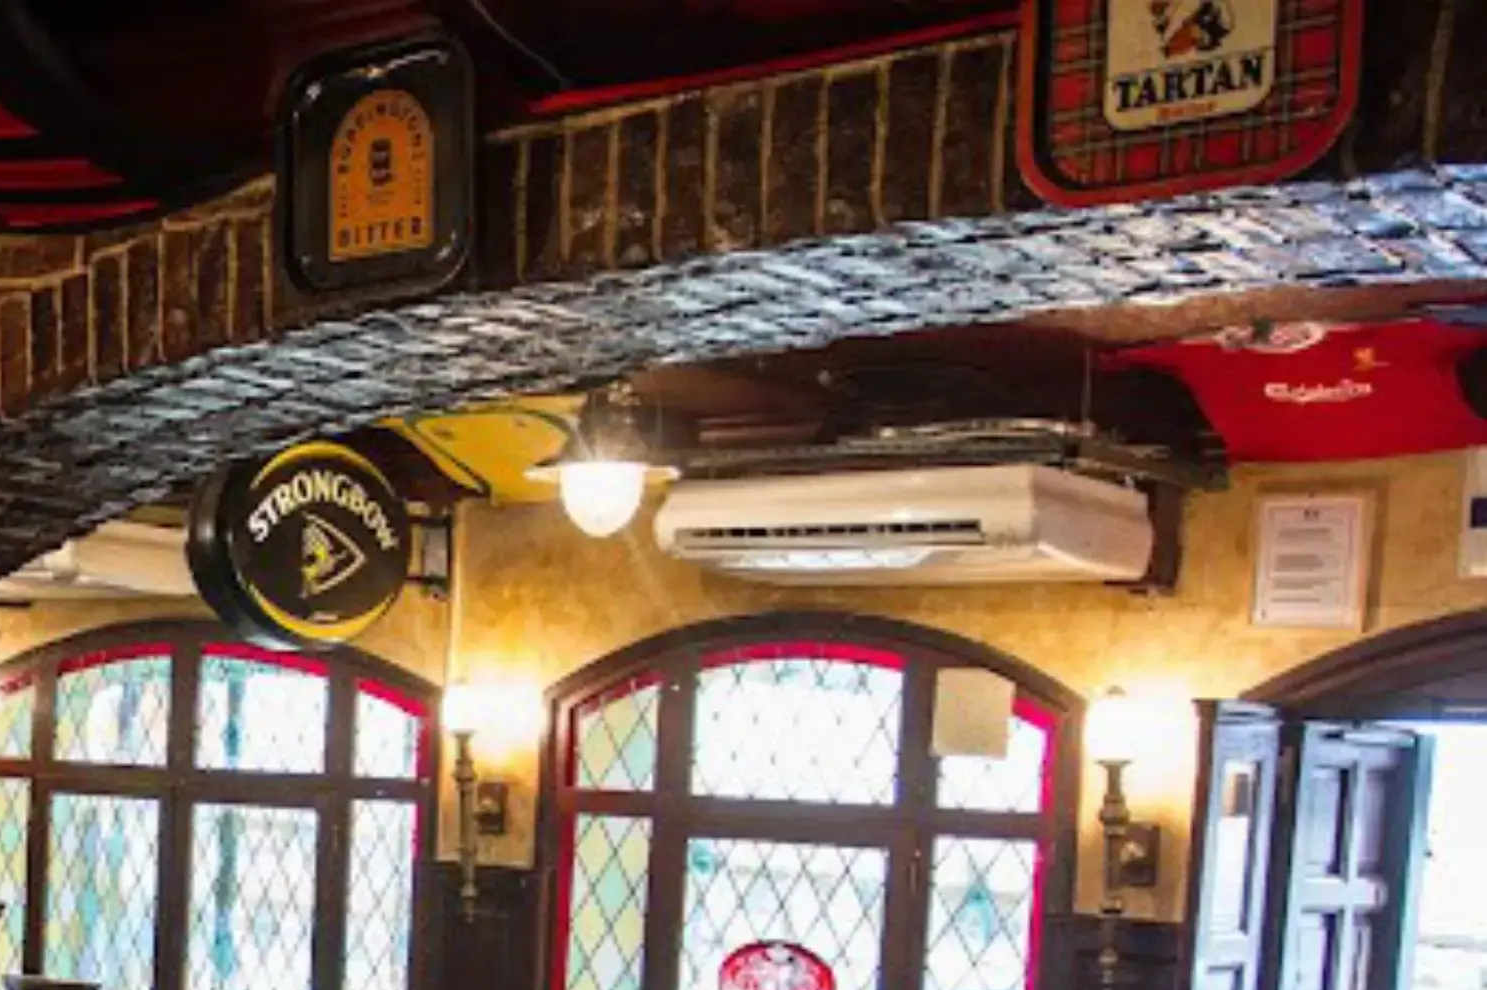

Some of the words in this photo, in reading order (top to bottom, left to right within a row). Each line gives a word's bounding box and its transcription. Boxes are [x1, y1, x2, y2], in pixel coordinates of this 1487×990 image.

[1115, 54, 1263, 112] TARTAN
[337, 216, 422, 248] BITTER
[247, 468, 399, 551] STRONGBOW
